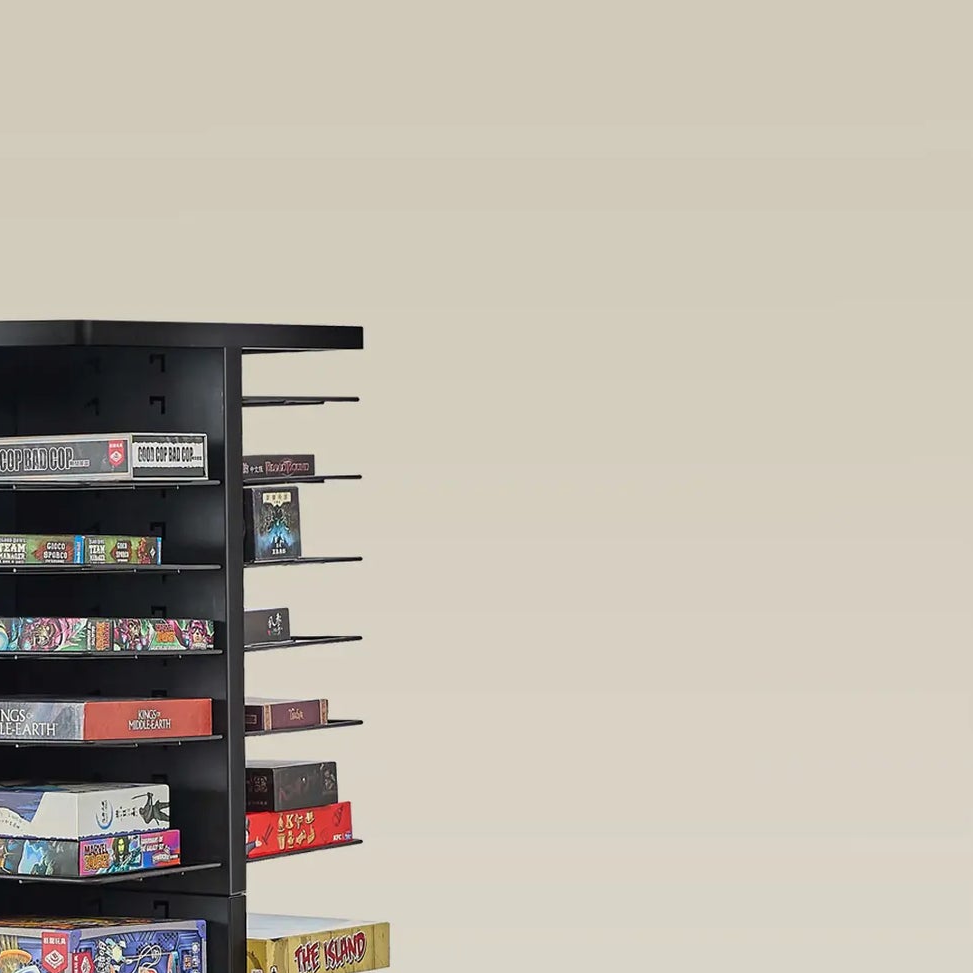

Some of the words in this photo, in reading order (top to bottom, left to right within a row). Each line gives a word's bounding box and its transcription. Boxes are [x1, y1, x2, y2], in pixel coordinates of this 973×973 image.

[0, 448, 22, 473] COP
[24, 448, 49, 471] BAD
[50, 446, 74, 470] COP
[137, 446, 155, 463] GOOD
[155, 445, 168, 462] COP
[168, 444, 180, 461] BAD
[181, 443, 194, 460] COP
[128, 718, 171, 730] MIDDLE-EARTH
[138, 709, 157, 720] KINGS
[323, 931, 367, 971] ISLAND
